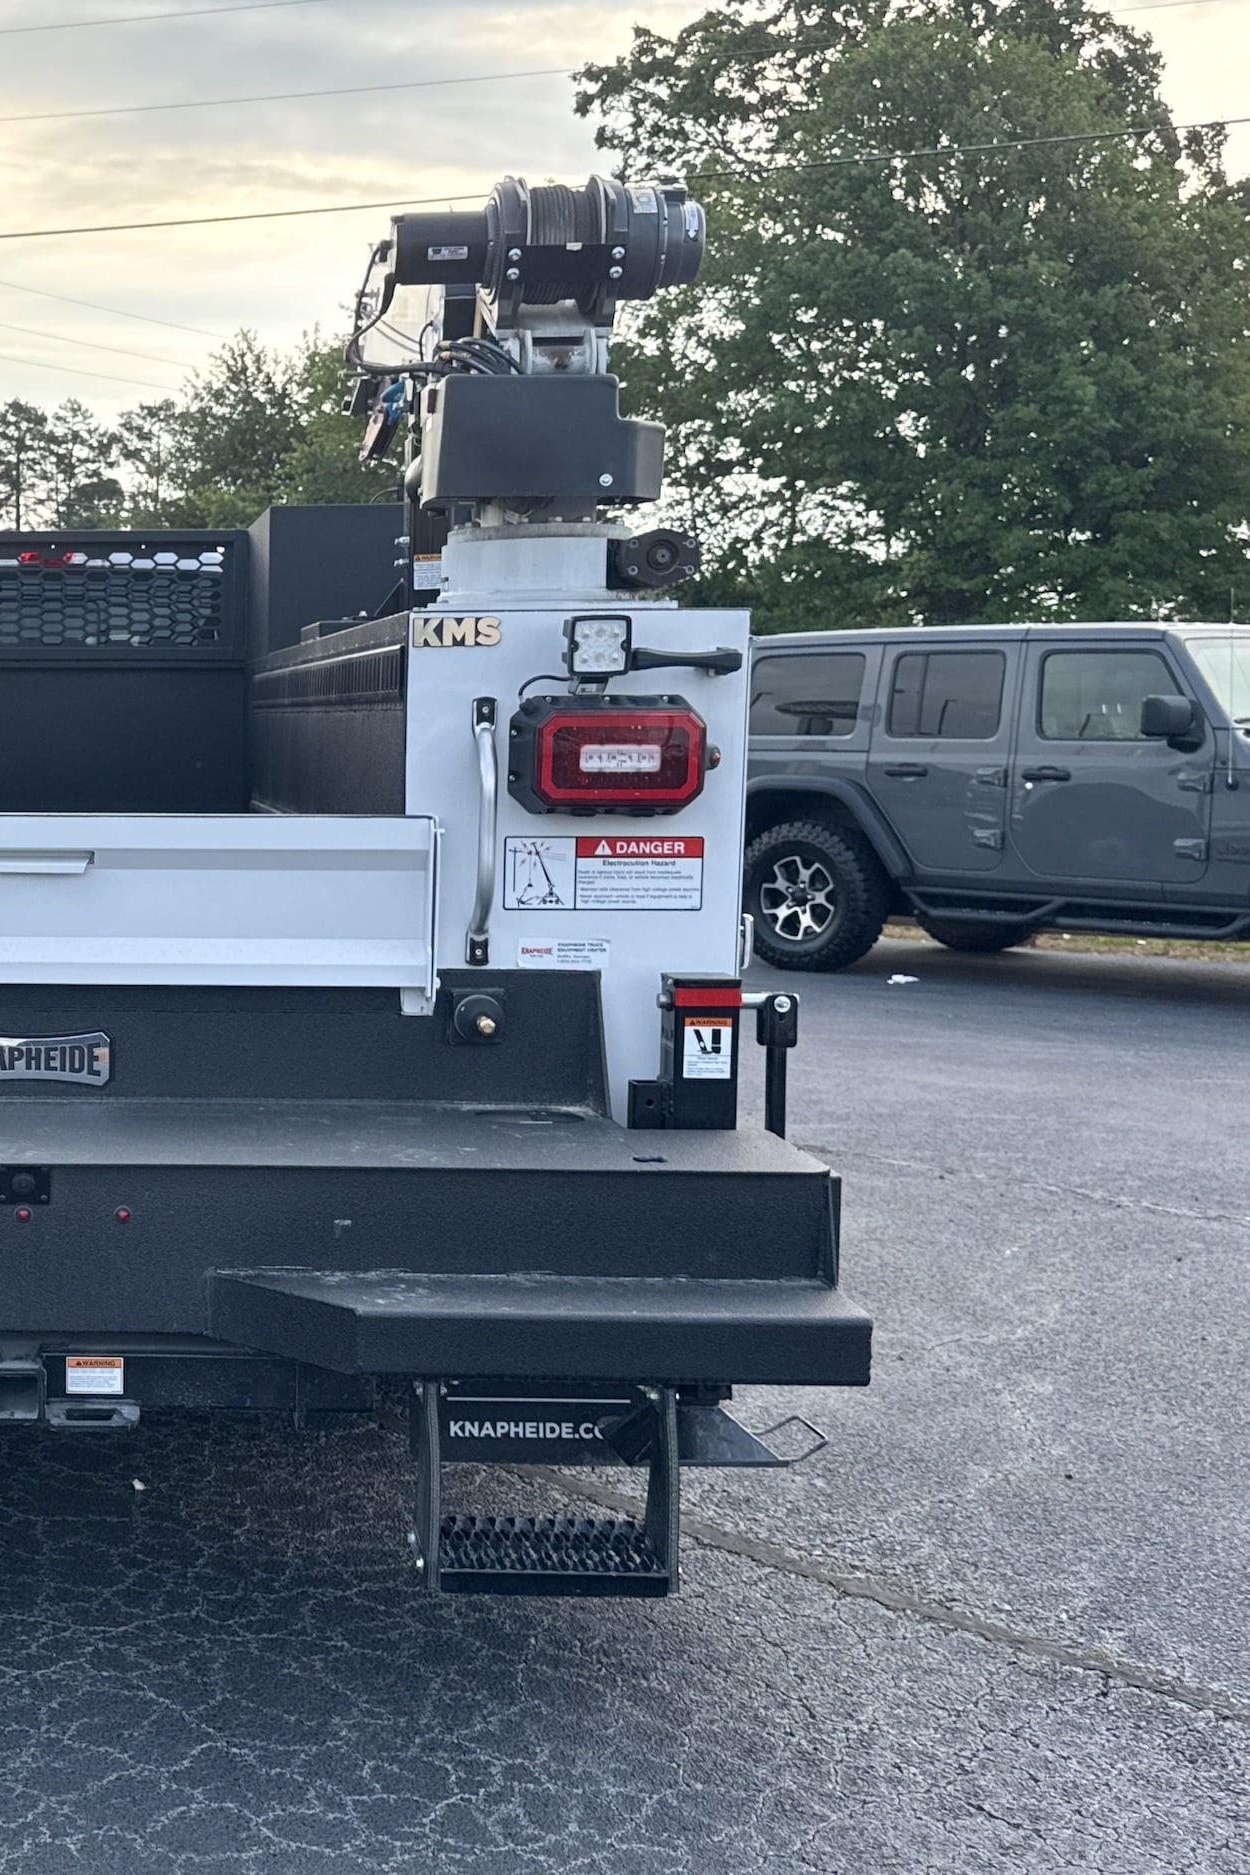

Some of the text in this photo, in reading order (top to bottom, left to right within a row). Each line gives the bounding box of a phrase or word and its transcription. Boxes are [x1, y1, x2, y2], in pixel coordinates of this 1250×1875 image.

[413, 616, 502, 647] KMS
[616, 841, 685, 854] DANGER
[449, 1420, 604, 1439] KNAPHEIDE.C
